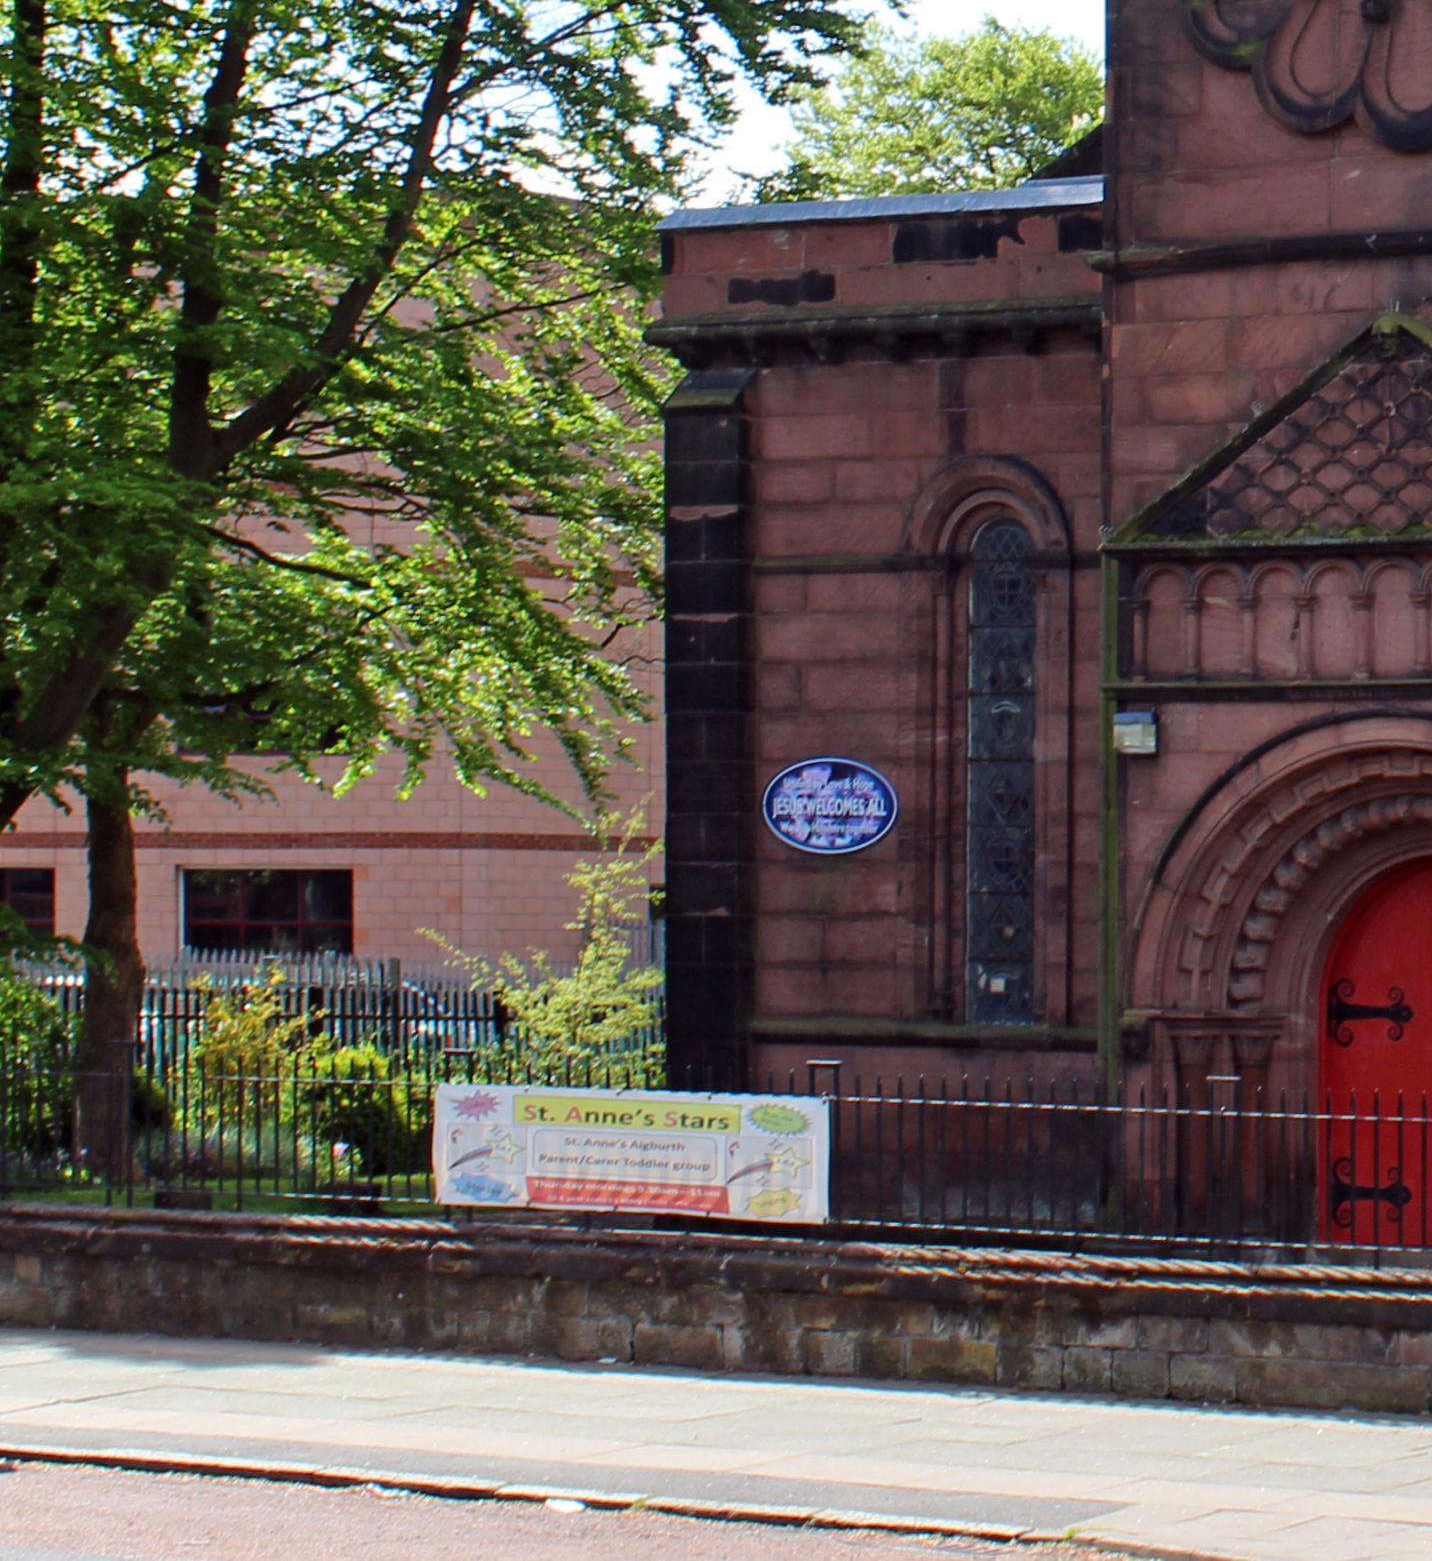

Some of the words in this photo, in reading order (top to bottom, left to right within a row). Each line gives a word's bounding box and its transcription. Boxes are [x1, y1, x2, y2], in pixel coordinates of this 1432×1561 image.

[806, 798, 865, 816] WELCOMES
[865, 799, 887, 816] ALL
[523, 1104, 556, 1122] St.
[565, 1106, 656, 1127] Anne's
[663, 1111, 730, 1130] Stars
[564, 1137, 581, 1148] St.
[630, 1139, 686, 1153] Aigburth
[538, 1153, 621, 1166] Parent/Carer
[623, 1157, 670, 1169] Toddler
[672, 1160, 711, 1172] group
[533, 1180, 583, 1192] Thursday
